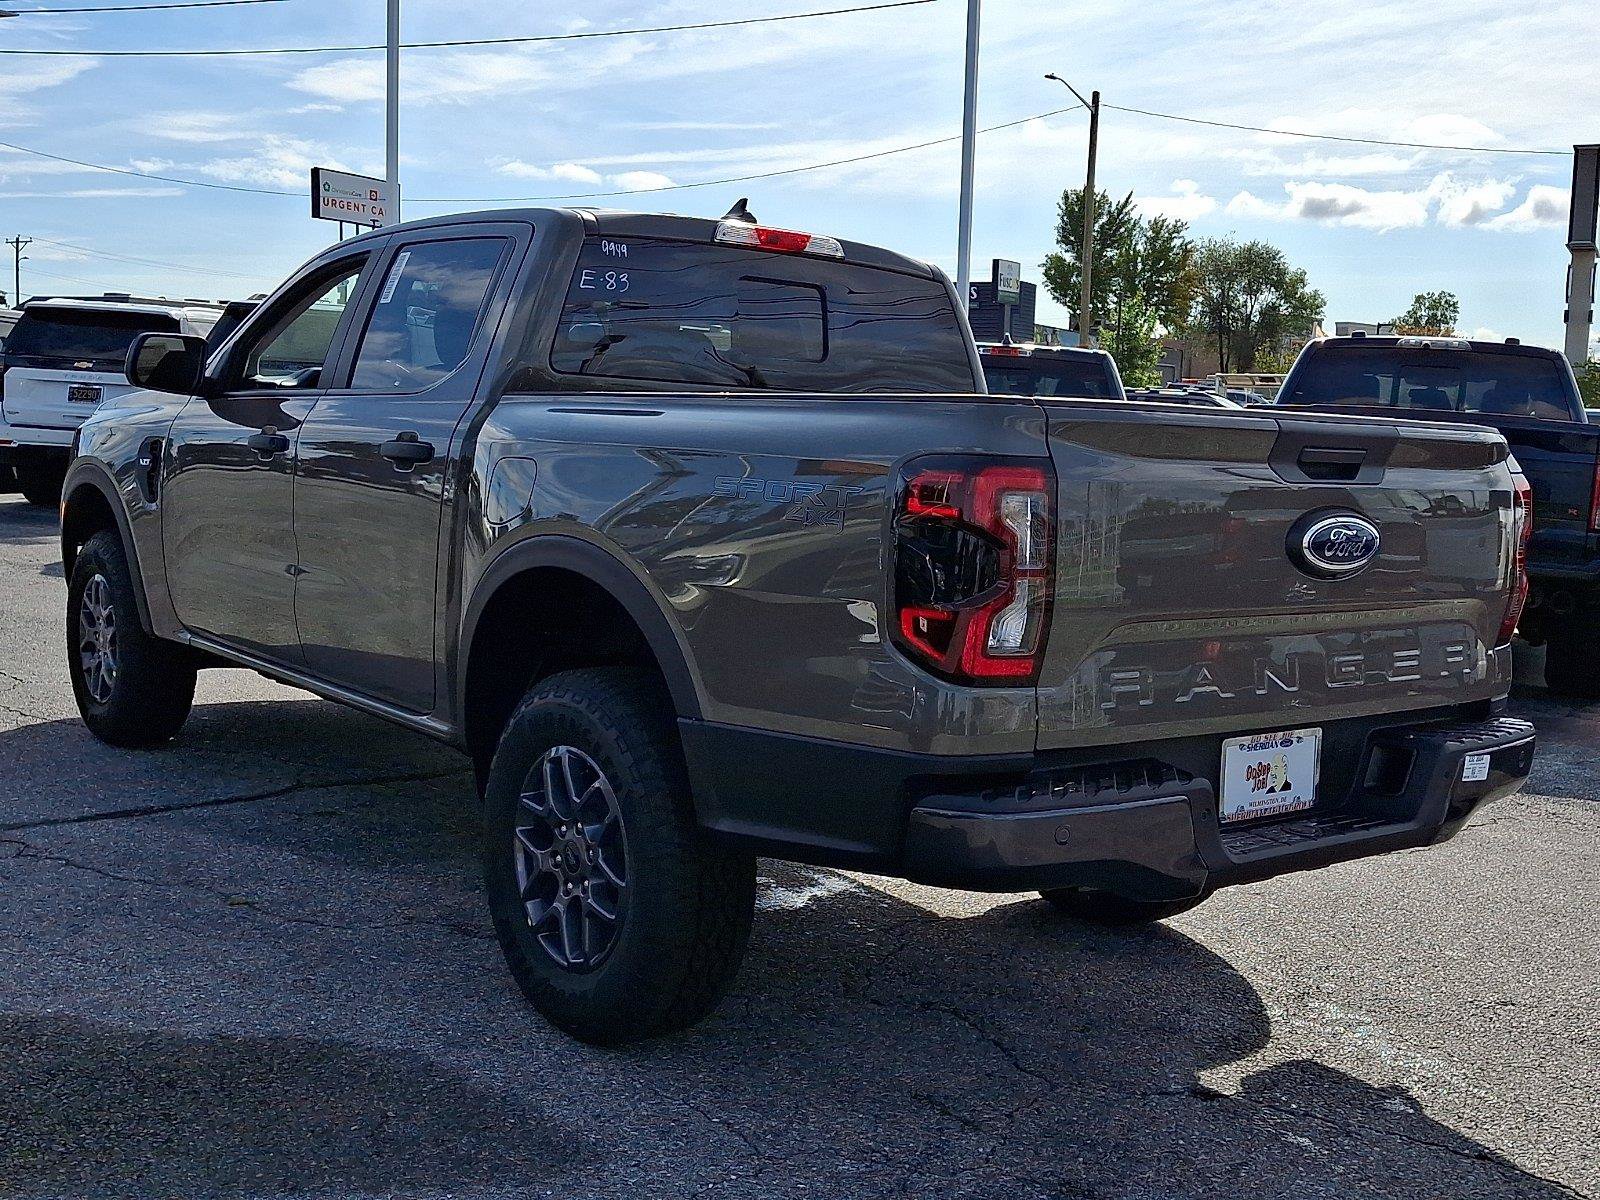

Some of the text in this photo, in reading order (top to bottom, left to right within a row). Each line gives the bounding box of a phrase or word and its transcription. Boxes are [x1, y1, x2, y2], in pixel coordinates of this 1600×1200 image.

[322, 197, 386, 217] URGENT CA
[711, 475, 864, 508] SPORT
[1324, 527, 1367, 558] Ford
[1100, 638, 1476, 710] RANGER
[1246, 740, 1279, 753] SHERIDAN
